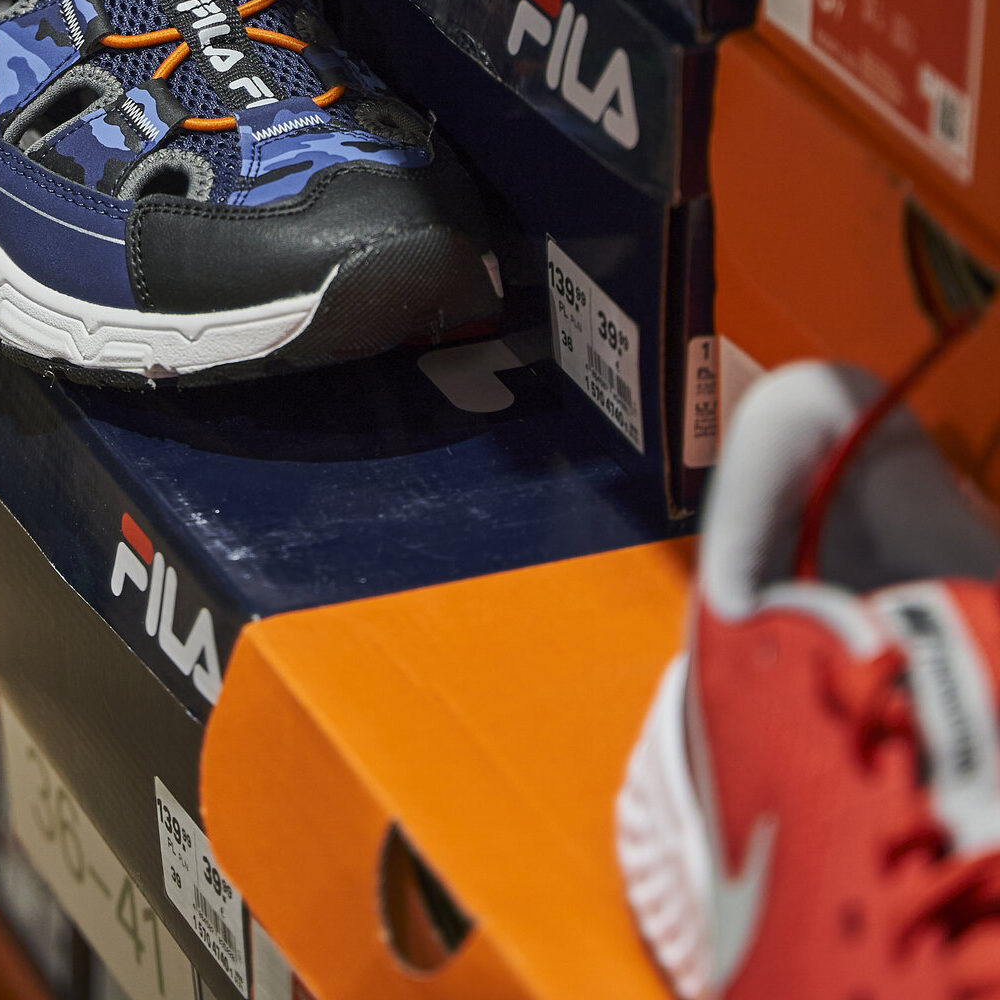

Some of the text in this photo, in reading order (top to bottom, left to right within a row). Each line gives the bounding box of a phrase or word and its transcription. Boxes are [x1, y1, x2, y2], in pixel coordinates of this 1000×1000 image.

[548, 261, 586, 312] 139.99
[111, 512, 223, 706] FILA
[157, 798, 192, 852] 139.99
[202, 855, 232, 903] 39.99
